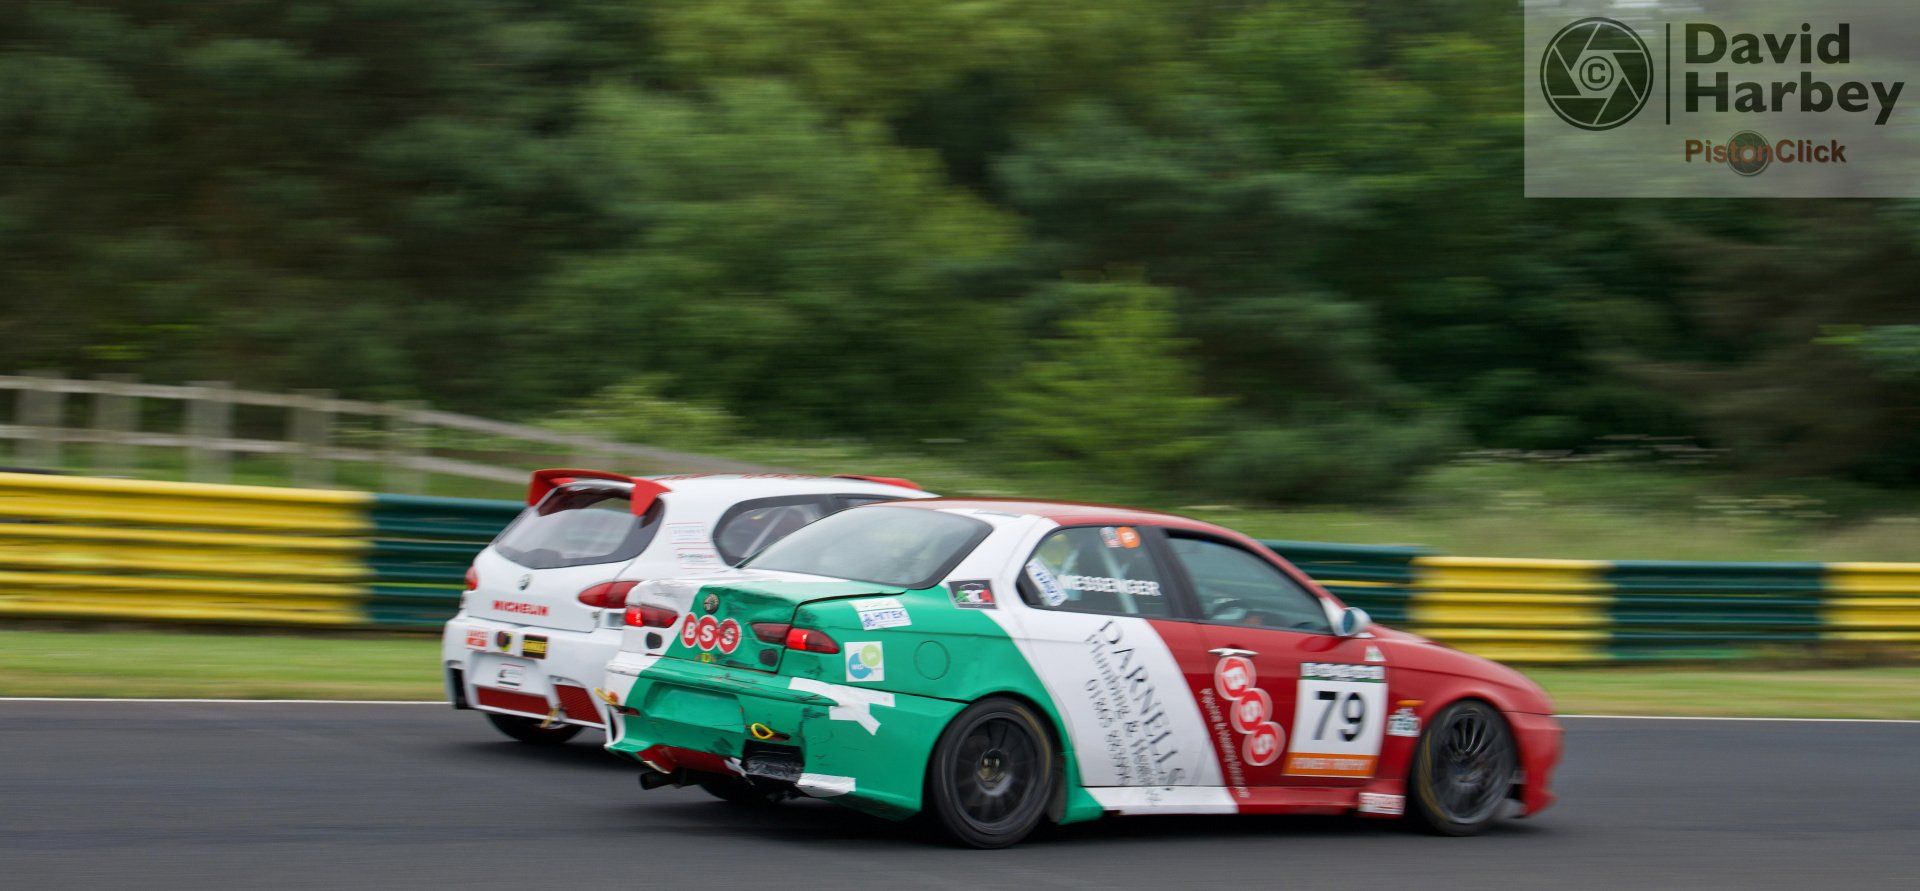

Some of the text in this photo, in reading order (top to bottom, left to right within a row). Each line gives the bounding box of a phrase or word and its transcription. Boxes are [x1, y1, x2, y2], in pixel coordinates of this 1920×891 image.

[492, 599, 550, 617] MICHELIN
[683, 621, 736, 646] BSS
[1098, 618, 1186, 792] DARNELLS
[1311, 690, 1366, 743] 79
